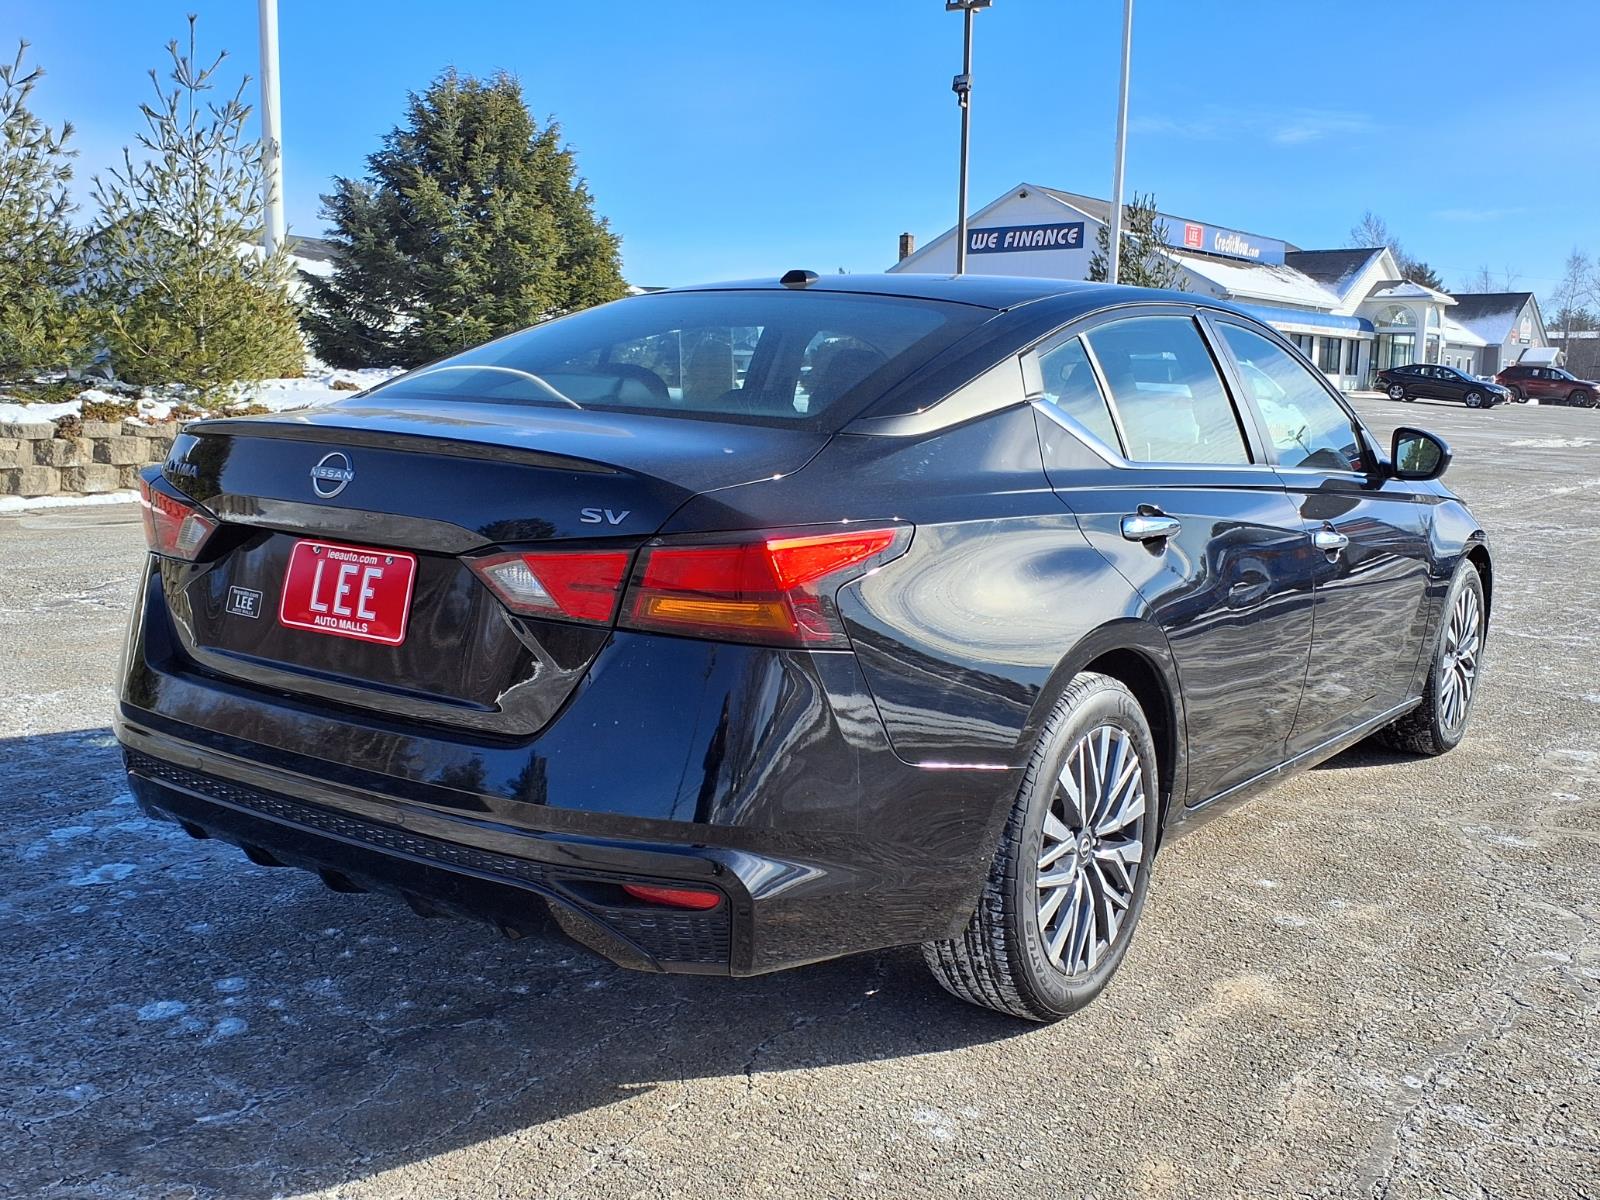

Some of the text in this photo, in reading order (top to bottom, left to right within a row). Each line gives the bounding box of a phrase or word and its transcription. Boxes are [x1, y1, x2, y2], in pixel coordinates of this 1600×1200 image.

[971, 227, 1079, 250] WE FINANCE
[1214, 232, 1260, 258] CreditNow.com
[310, 467, 354, 481] NISSAN
[580, 507, 631, 525] SV
[327, 549, 378, 565] leeauto.com
[309, 560, 384, 621] LEE
[235, 594, 254, 611] LEE
[314, 615, 368, 632] AUTO MALLS
